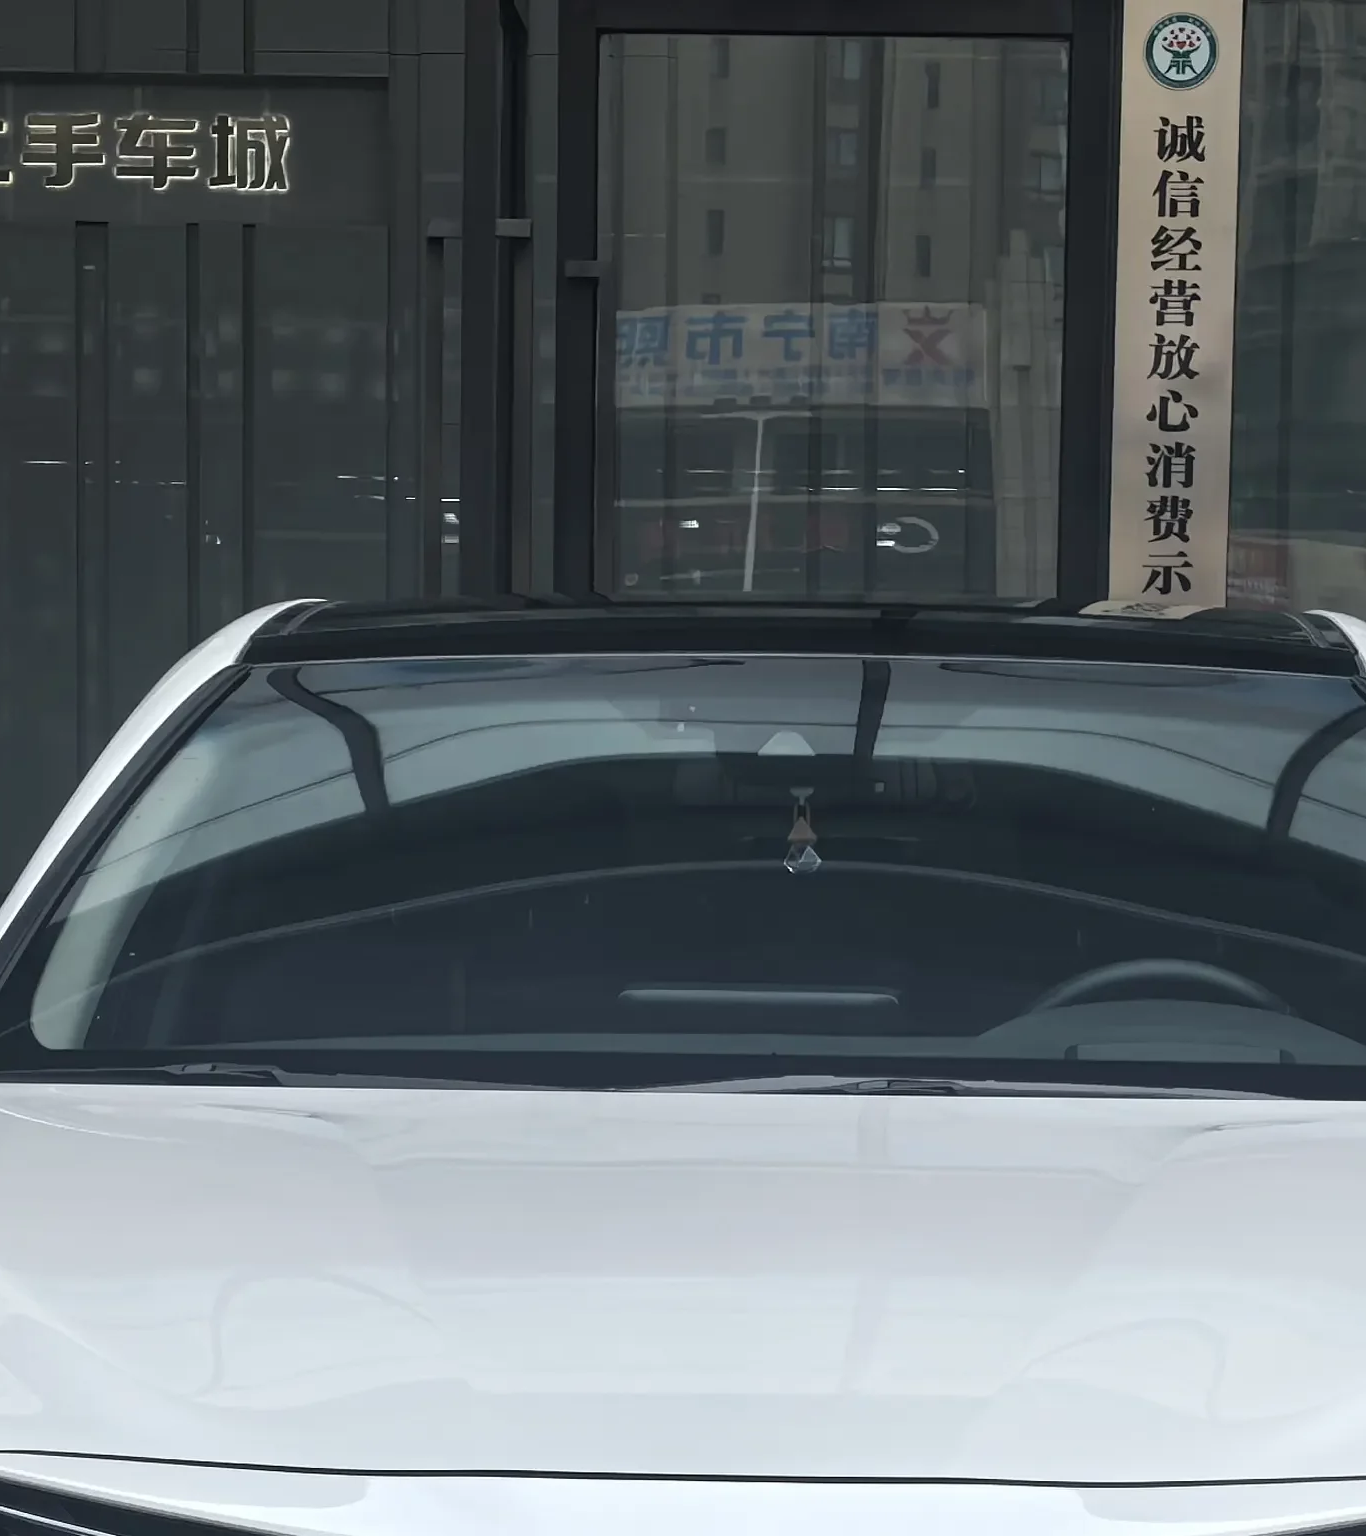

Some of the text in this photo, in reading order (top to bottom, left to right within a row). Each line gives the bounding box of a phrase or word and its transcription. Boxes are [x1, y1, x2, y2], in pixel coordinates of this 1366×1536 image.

[1140, 115, 1206, 595] 诚信经营放心消费示
